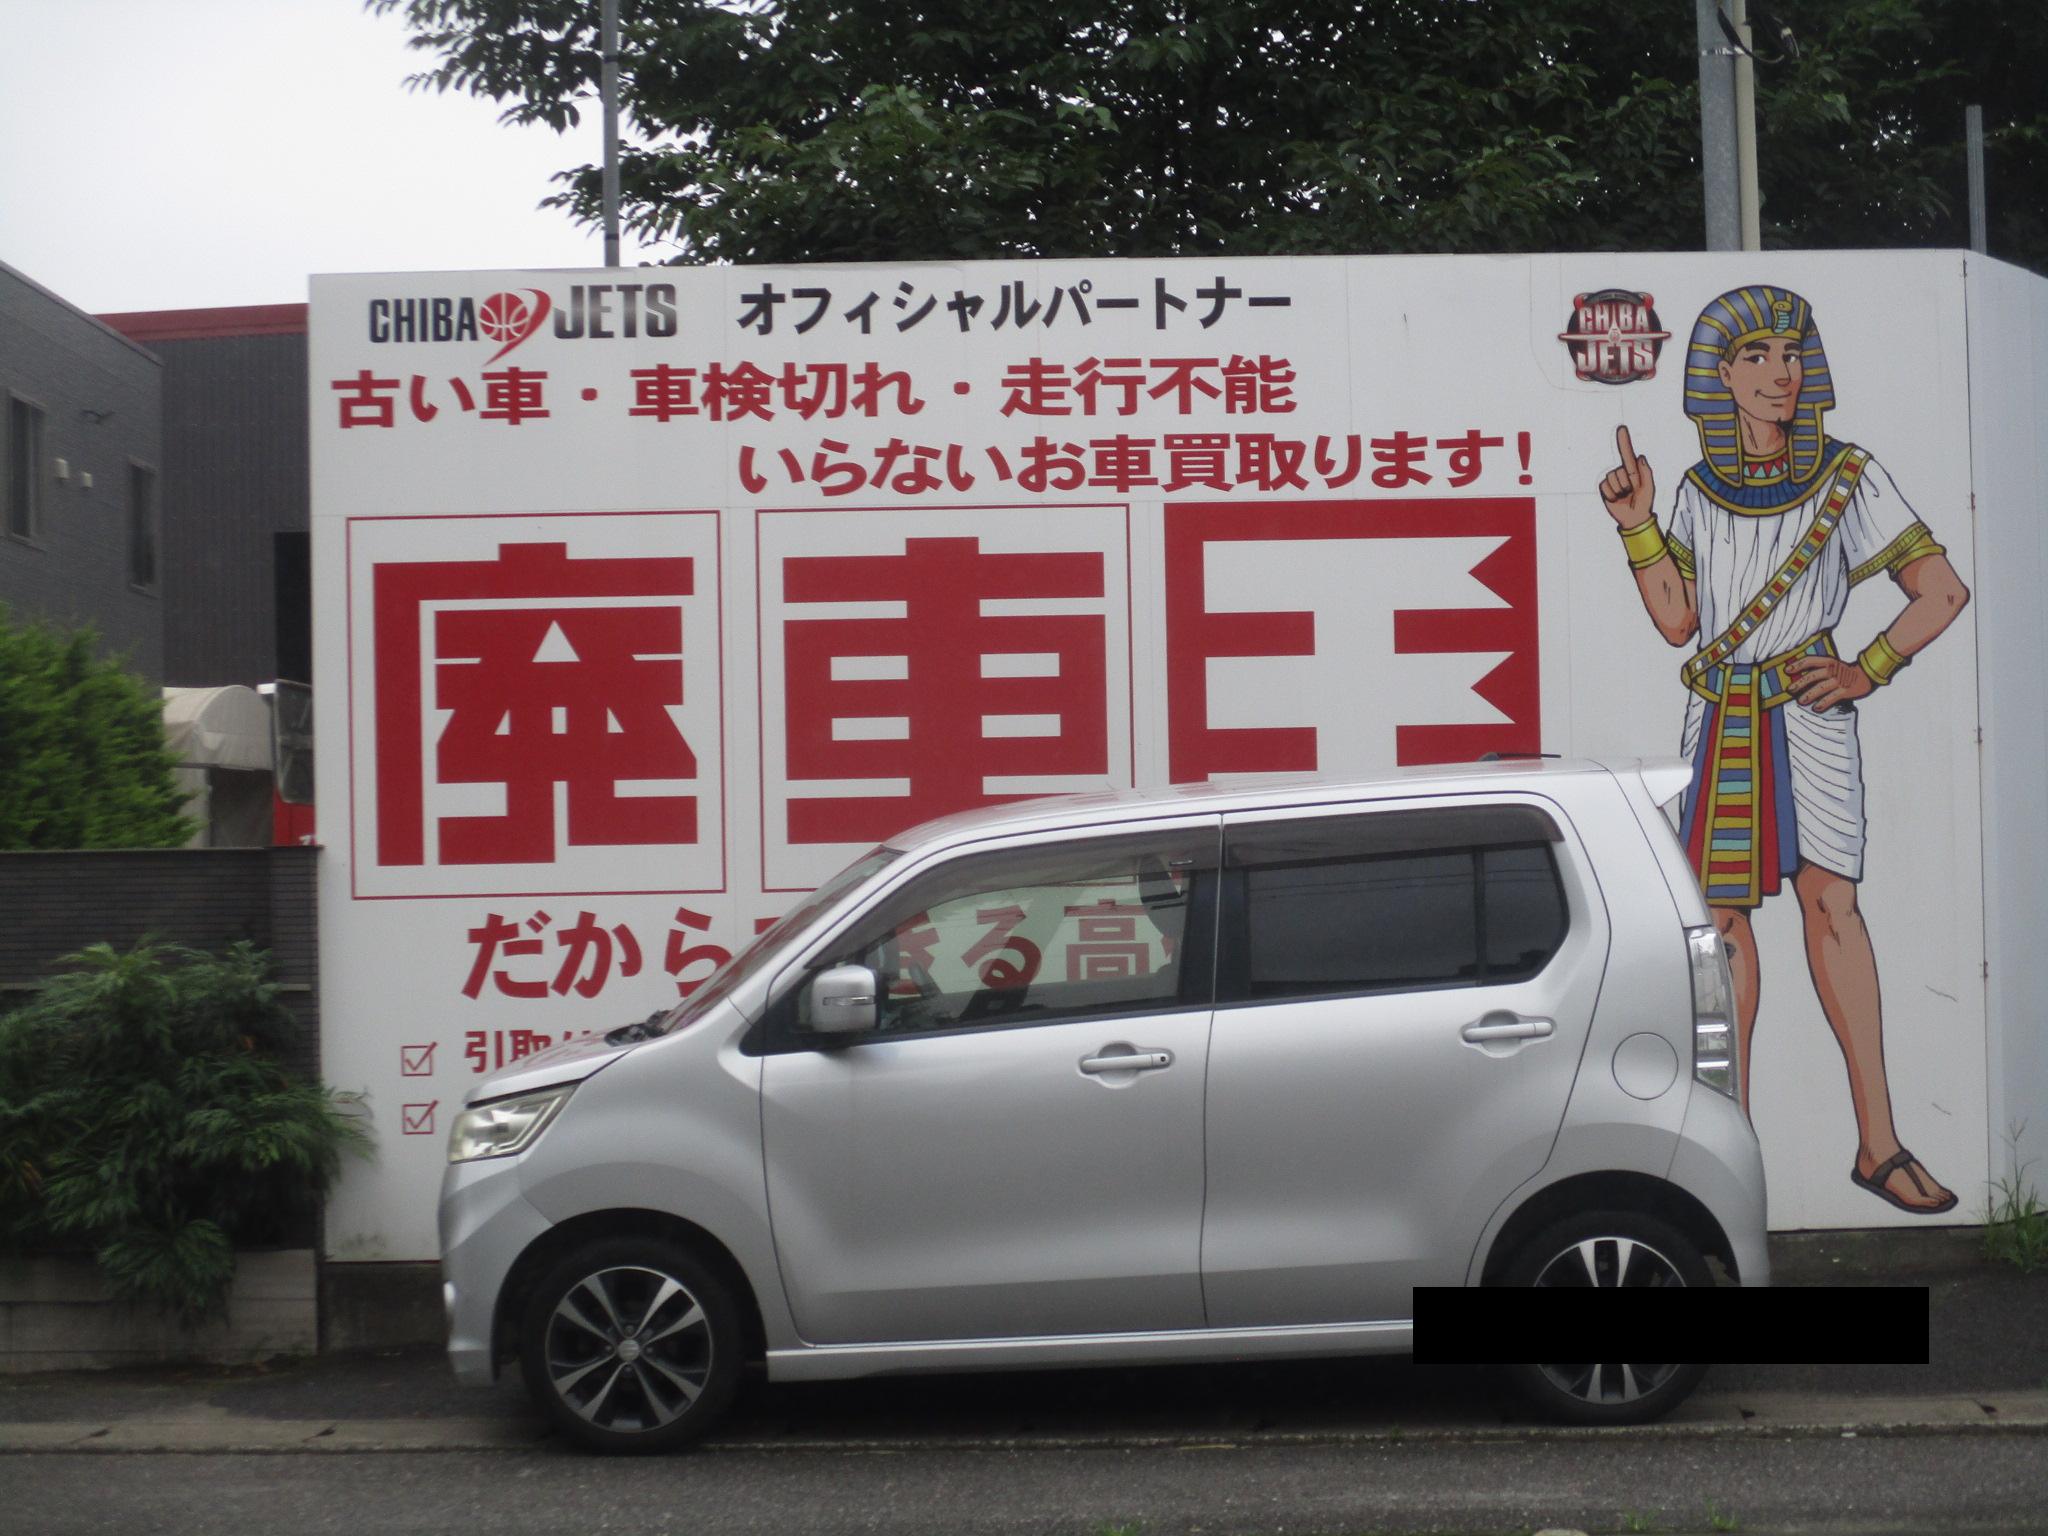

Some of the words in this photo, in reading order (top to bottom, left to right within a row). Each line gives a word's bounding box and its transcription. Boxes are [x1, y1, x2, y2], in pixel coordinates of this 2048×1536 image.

[368, 297, 478, 343] CHIBA
[553, 283, 677, 339] JETS
[737, 276, 1292, 335] オフィシャルパートナー
[1578, 303, 1650, 332] CHIBA
[1577, 340, 1654, 375] JETS
